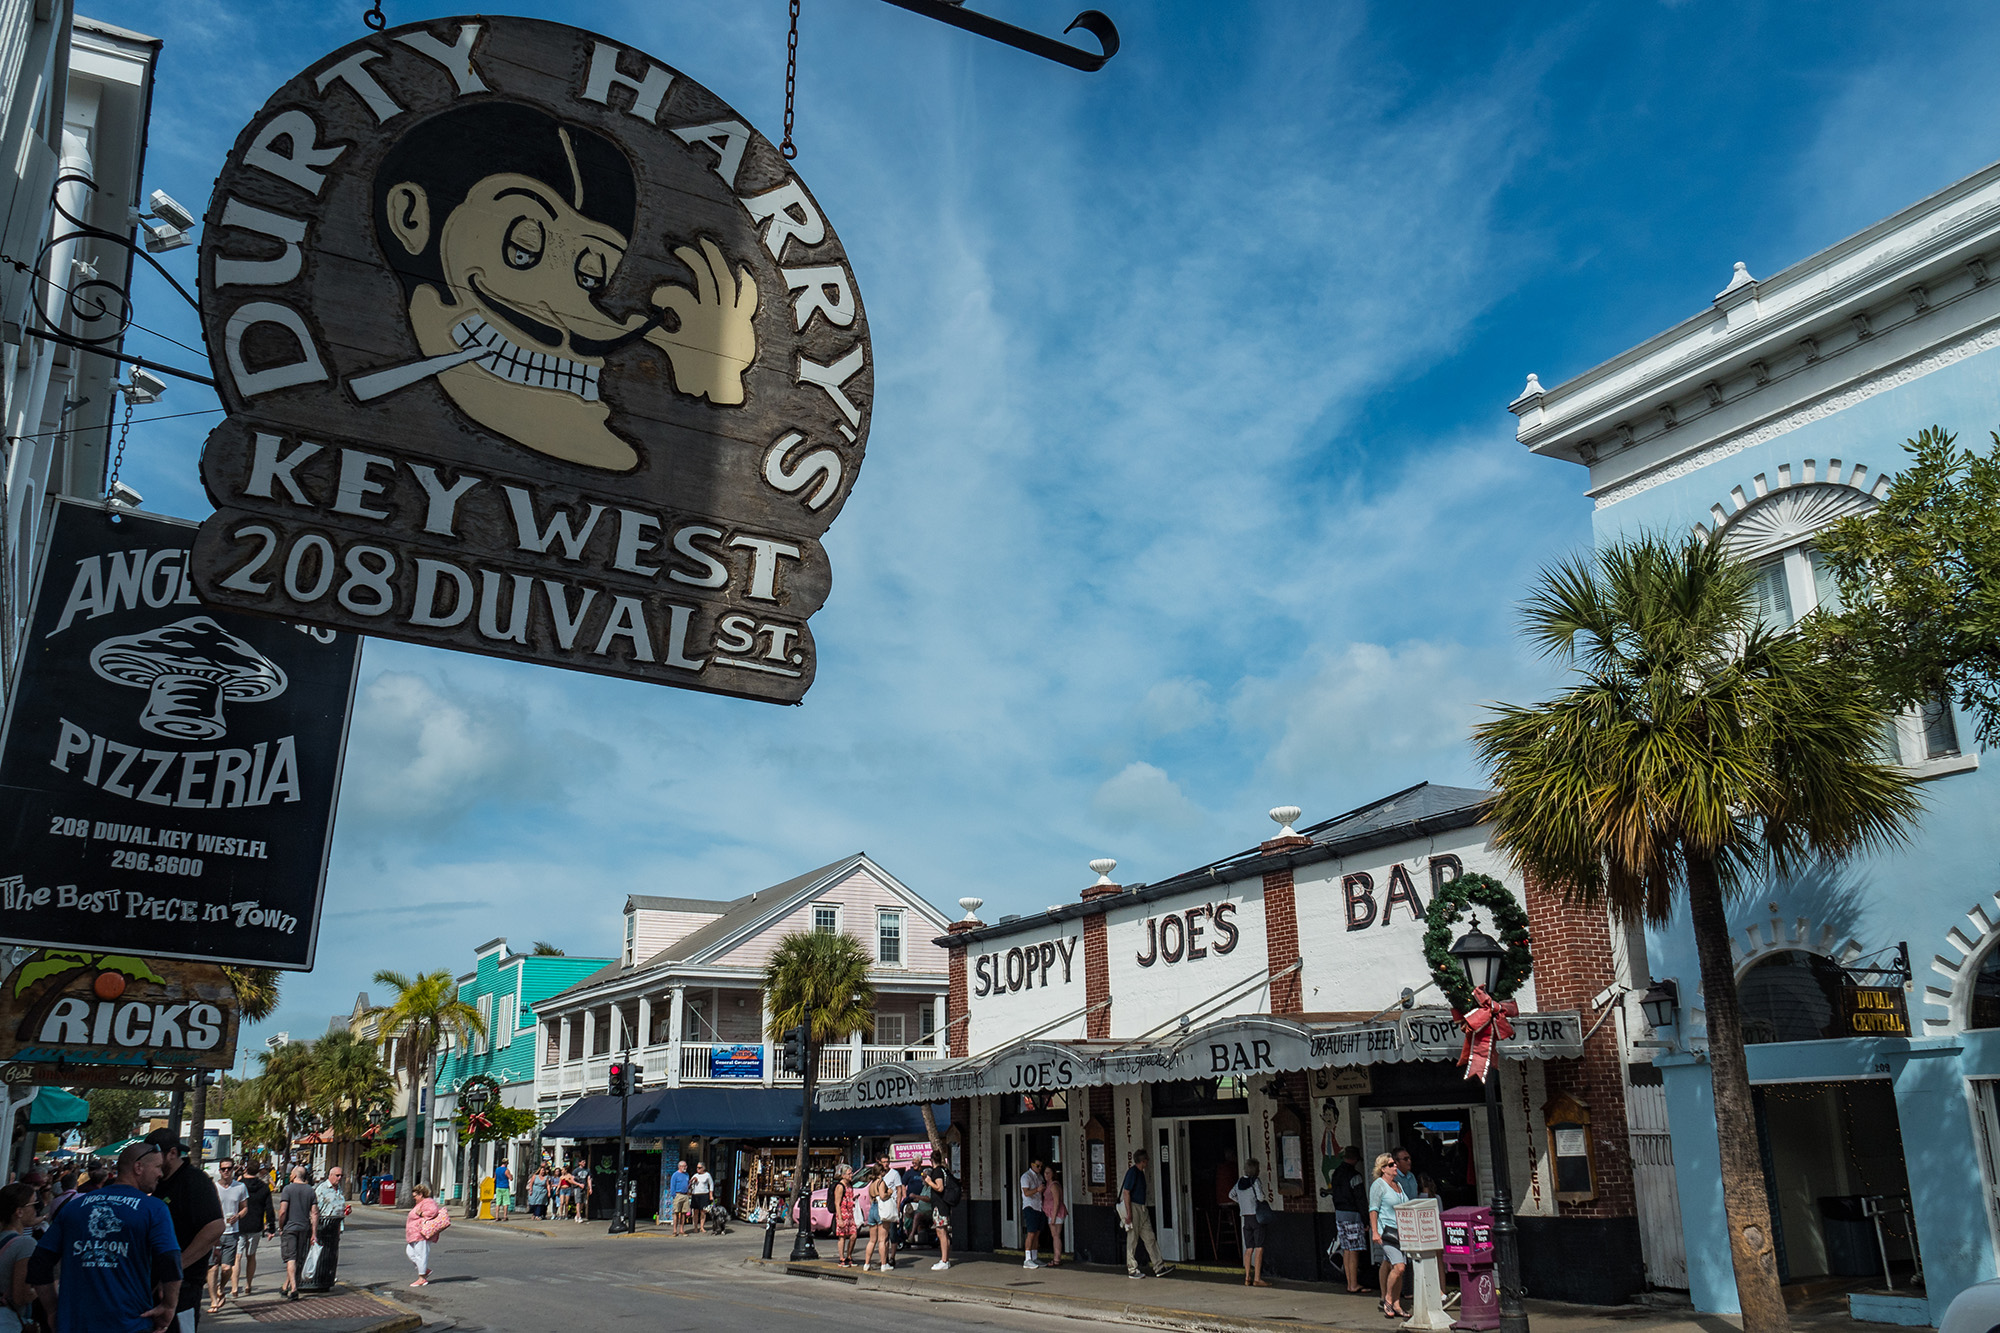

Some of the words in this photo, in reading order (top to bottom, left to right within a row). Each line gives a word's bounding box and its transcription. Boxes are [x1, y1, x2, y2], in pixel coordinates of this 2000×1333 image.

[214, 23, 490, 398] DURTY
[581, 40, 866, 512] HARRY'S
[246, 431, 482, 537] KEY
[501, 485, 802, 604] WEST
[221, 525, 396, 617] 208
[409, 556, 706, 671] DUVAL
[715, 614, 804, 665] ST.
[51, 717, 301, 809] PIZZERIA
[49, 816, 89, 838] 208
[93, 821, 193, 849] DUVAL.KEY
[197, 834, 268, 859] WEST.FL
[111, 850, 204, 877] 296.3600
[0, 874, 51, 911] The
[1342, 853, 1473, 932] BAR
[1136, 901, 1239, 968] JOE'S
[974, 935, 1077, 997] SLOPPY
[1856, 990, 1893, 1009] DUVAL
[39, 997, 222, 1050] RICK'S
[1409, 1019, 1460, 1045] SLOPP
[1527, 1020, 1564, 1041] BAR
[1852, 1013, 1905, 1031] CENTRAL
[1210, 1039, 1275, 1073] BAR
[1310, 1031, 1361, 1057] DRAUGHT
[1367, 1029, 1397, 1050] BEER
[129, 1071, 153, 1087] Key
[152, 1072, 180, 1085] West
[1009, 1058, 1074, 1089] JOE'S
[1874, 1063, 1890, 1073] 209
[857, 1074, 915, 1102] SLOPPY
[928, 1076, 945, 1094] PINA
[1518, 1060, 1541, 1210] NTERTAINMENT
[1262, 1109, 1274, 1203] COCKTAILS
[107, 1195, 141, 1210] BREATH
[1447, 1227, 1465, 1235] Florida
[1450, 1236, 1463, 1245] Keys
[73, 1240, 129, 1257] SALOON
